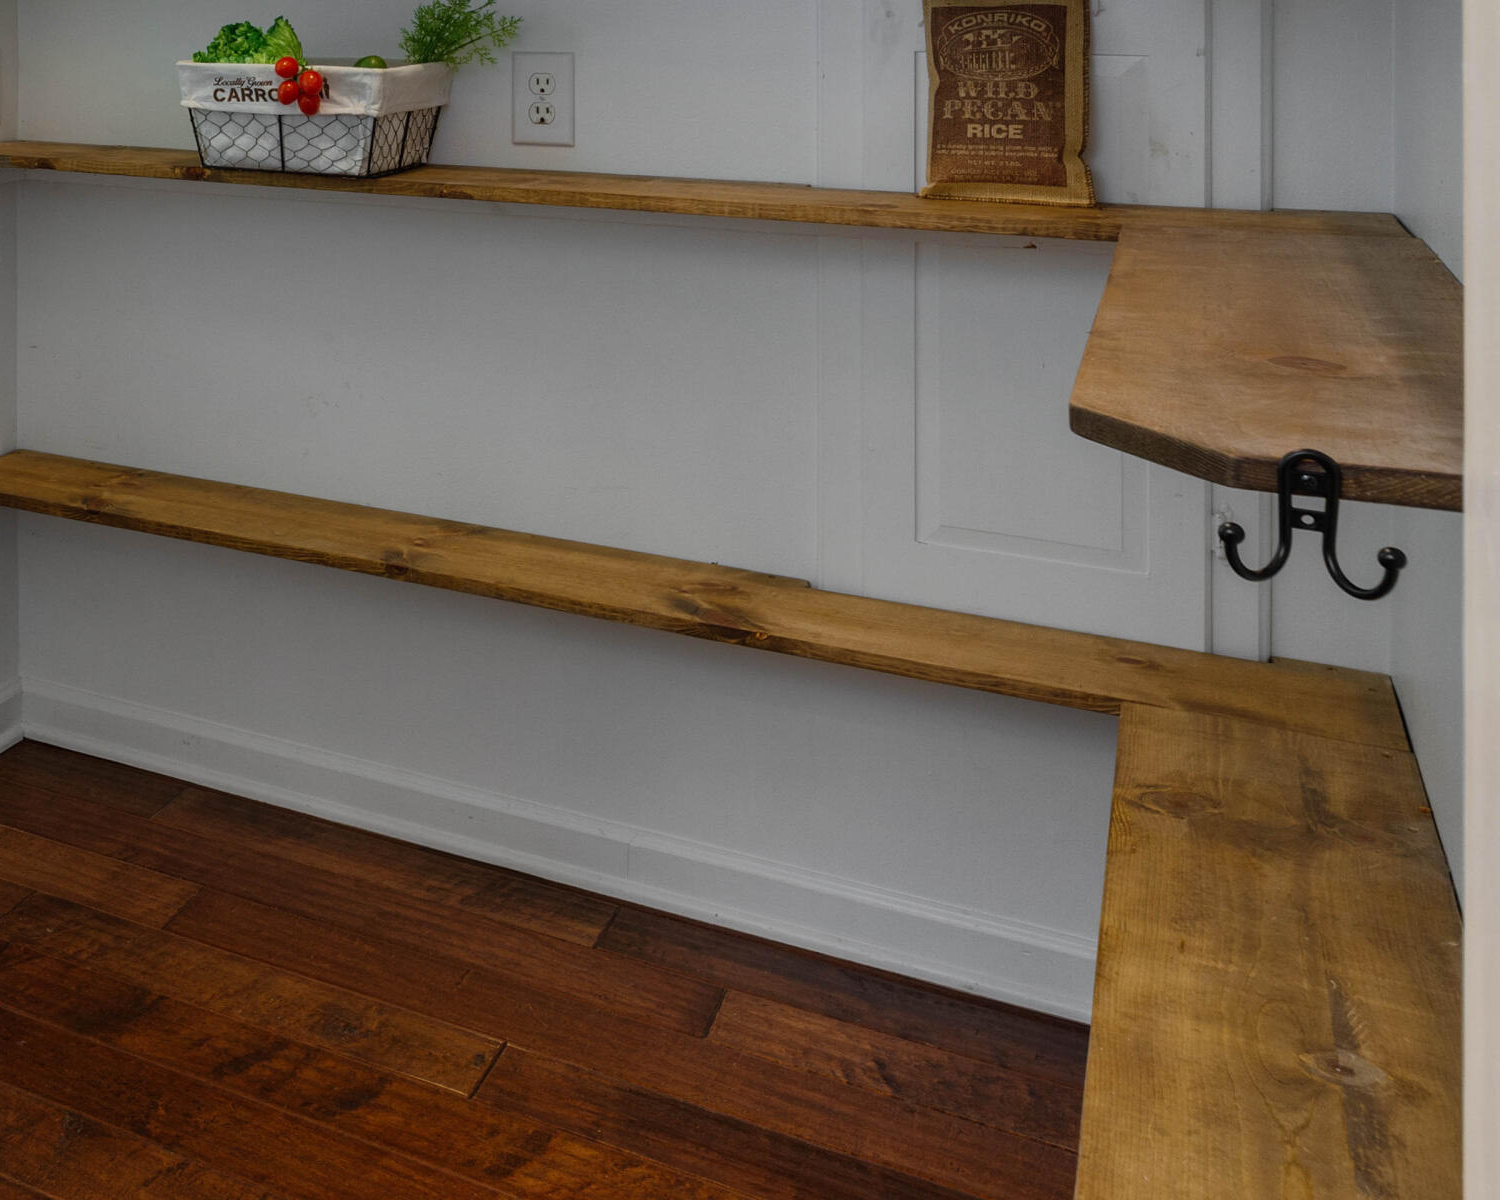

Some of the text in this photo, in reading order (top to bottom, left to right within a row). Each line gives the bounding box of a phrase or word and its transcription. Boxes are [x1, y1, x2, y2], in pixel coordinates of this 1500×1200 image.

[948, 13, 1047, 34] KONRIKO
[213, 76, 273, 88] Locally Grown
[958, 80, 1038, 99] WILD
[213, 88, 279, 102] CARRO
[943, 99, 1053, 121] PECAN
[967, 124, 1024, 139] RICE
